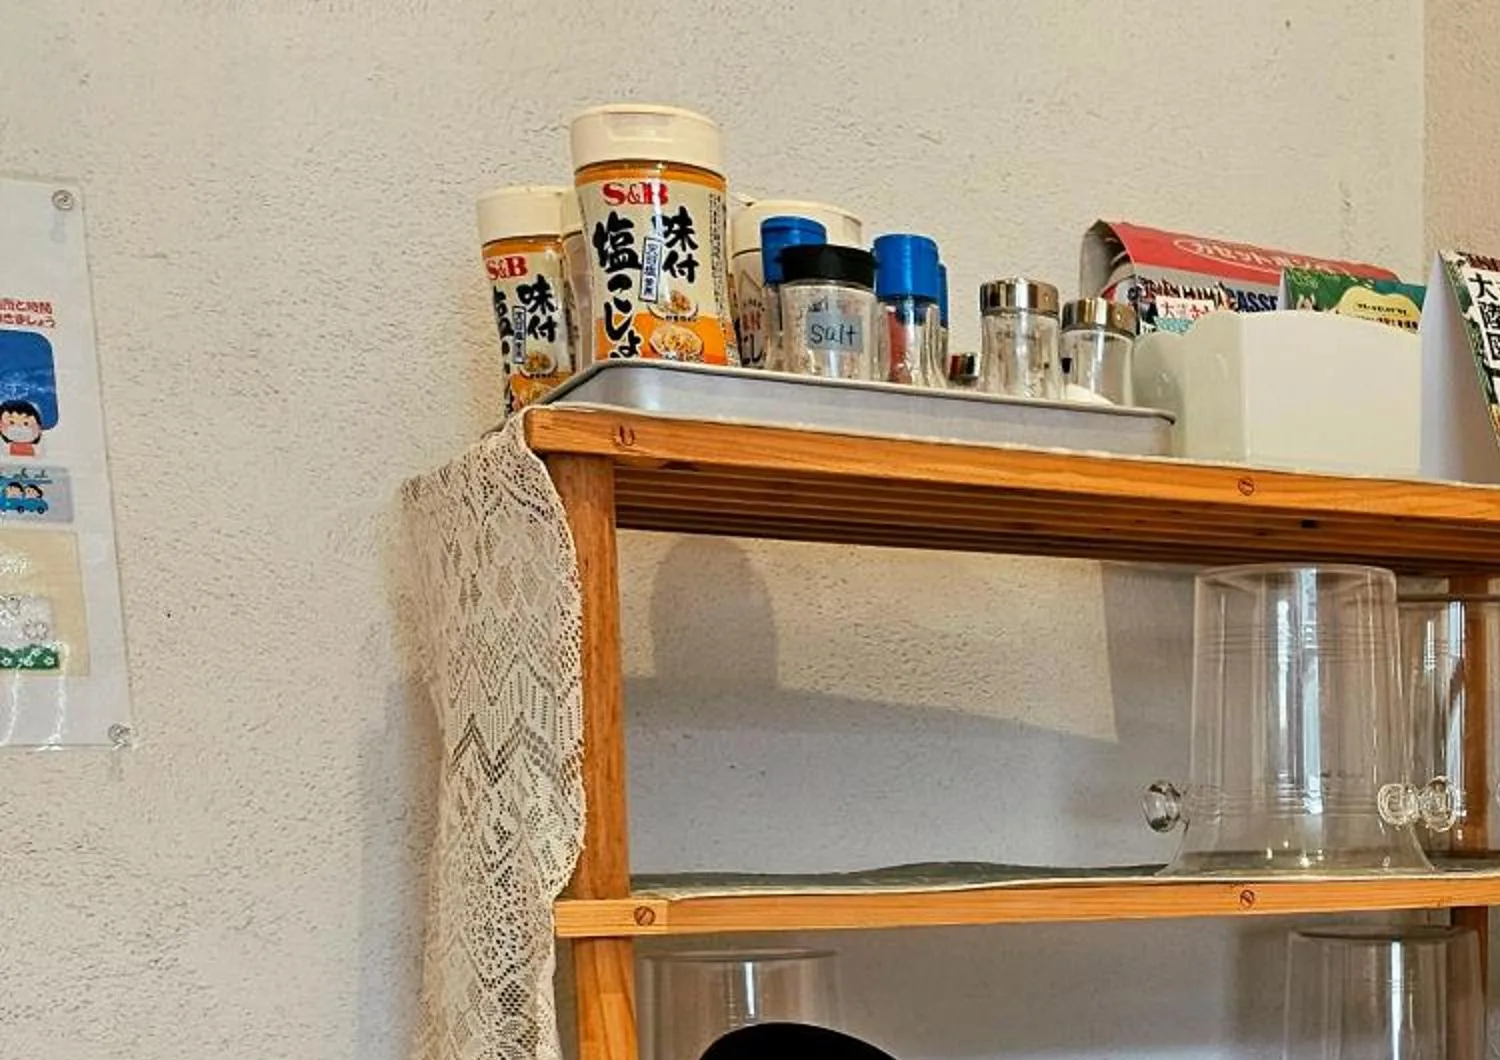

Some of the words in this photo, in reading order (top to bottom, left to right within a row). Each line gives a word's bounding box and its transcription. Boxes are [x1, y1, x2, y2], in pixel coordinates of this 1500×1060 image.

[602, 182, 669, 206] S&B
[486, 255, 528, 281] S&B
[651, 205, 700, 283] 味付
[515, 273, 557, 343] 味付
[592, 210, 643, 359] 塩こしょ
[0, 313, 55, 328] きましょう
